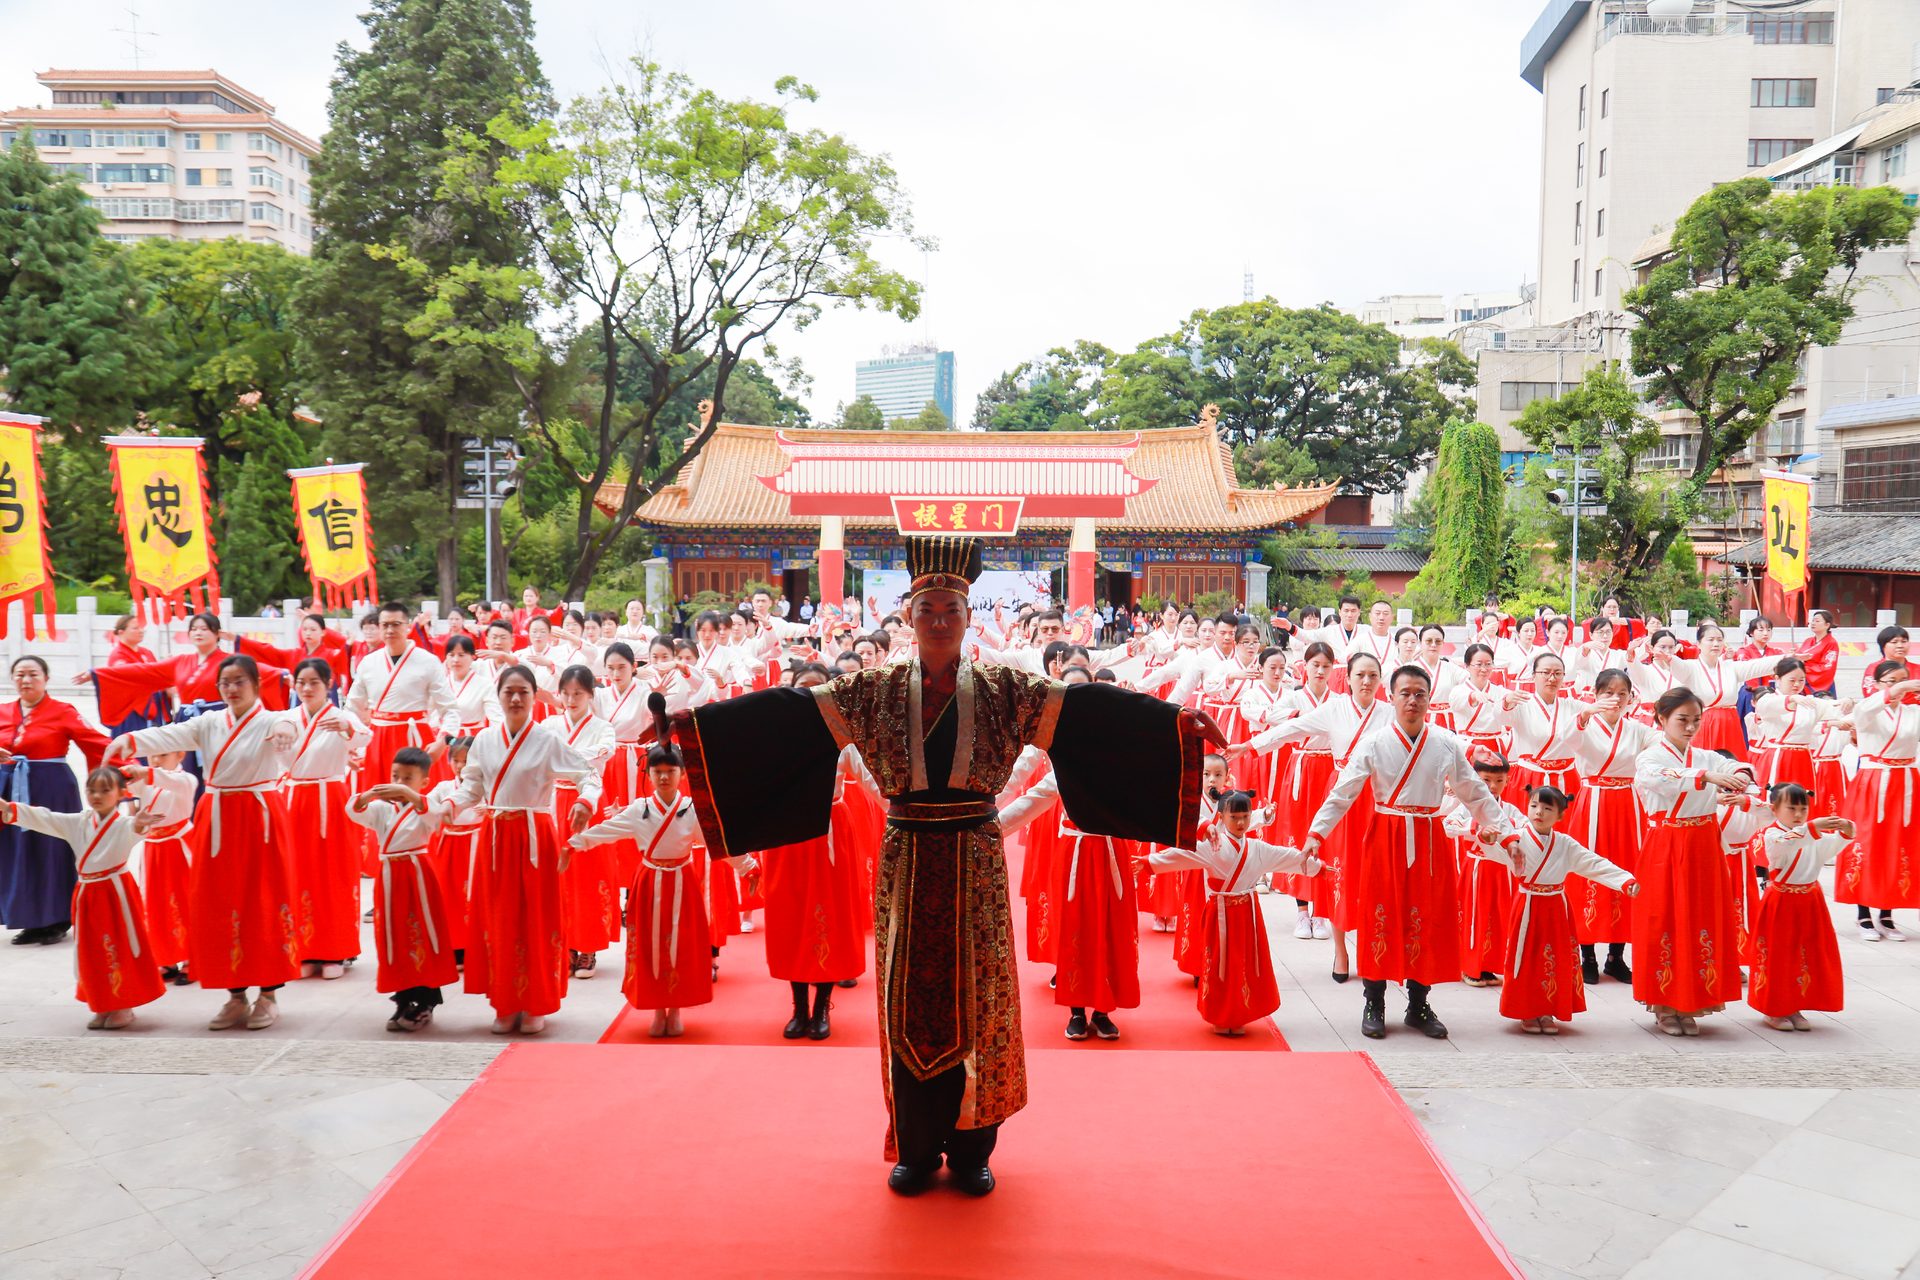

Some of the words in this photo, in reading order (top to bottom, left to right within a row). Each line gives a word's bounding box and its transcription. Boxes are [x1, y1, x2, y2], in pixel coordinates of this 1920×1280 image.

[140, 478, 192, 547] 忠
[308, 499, 357, 551] 信
[912, 502, 1003, 530] 棂星门
